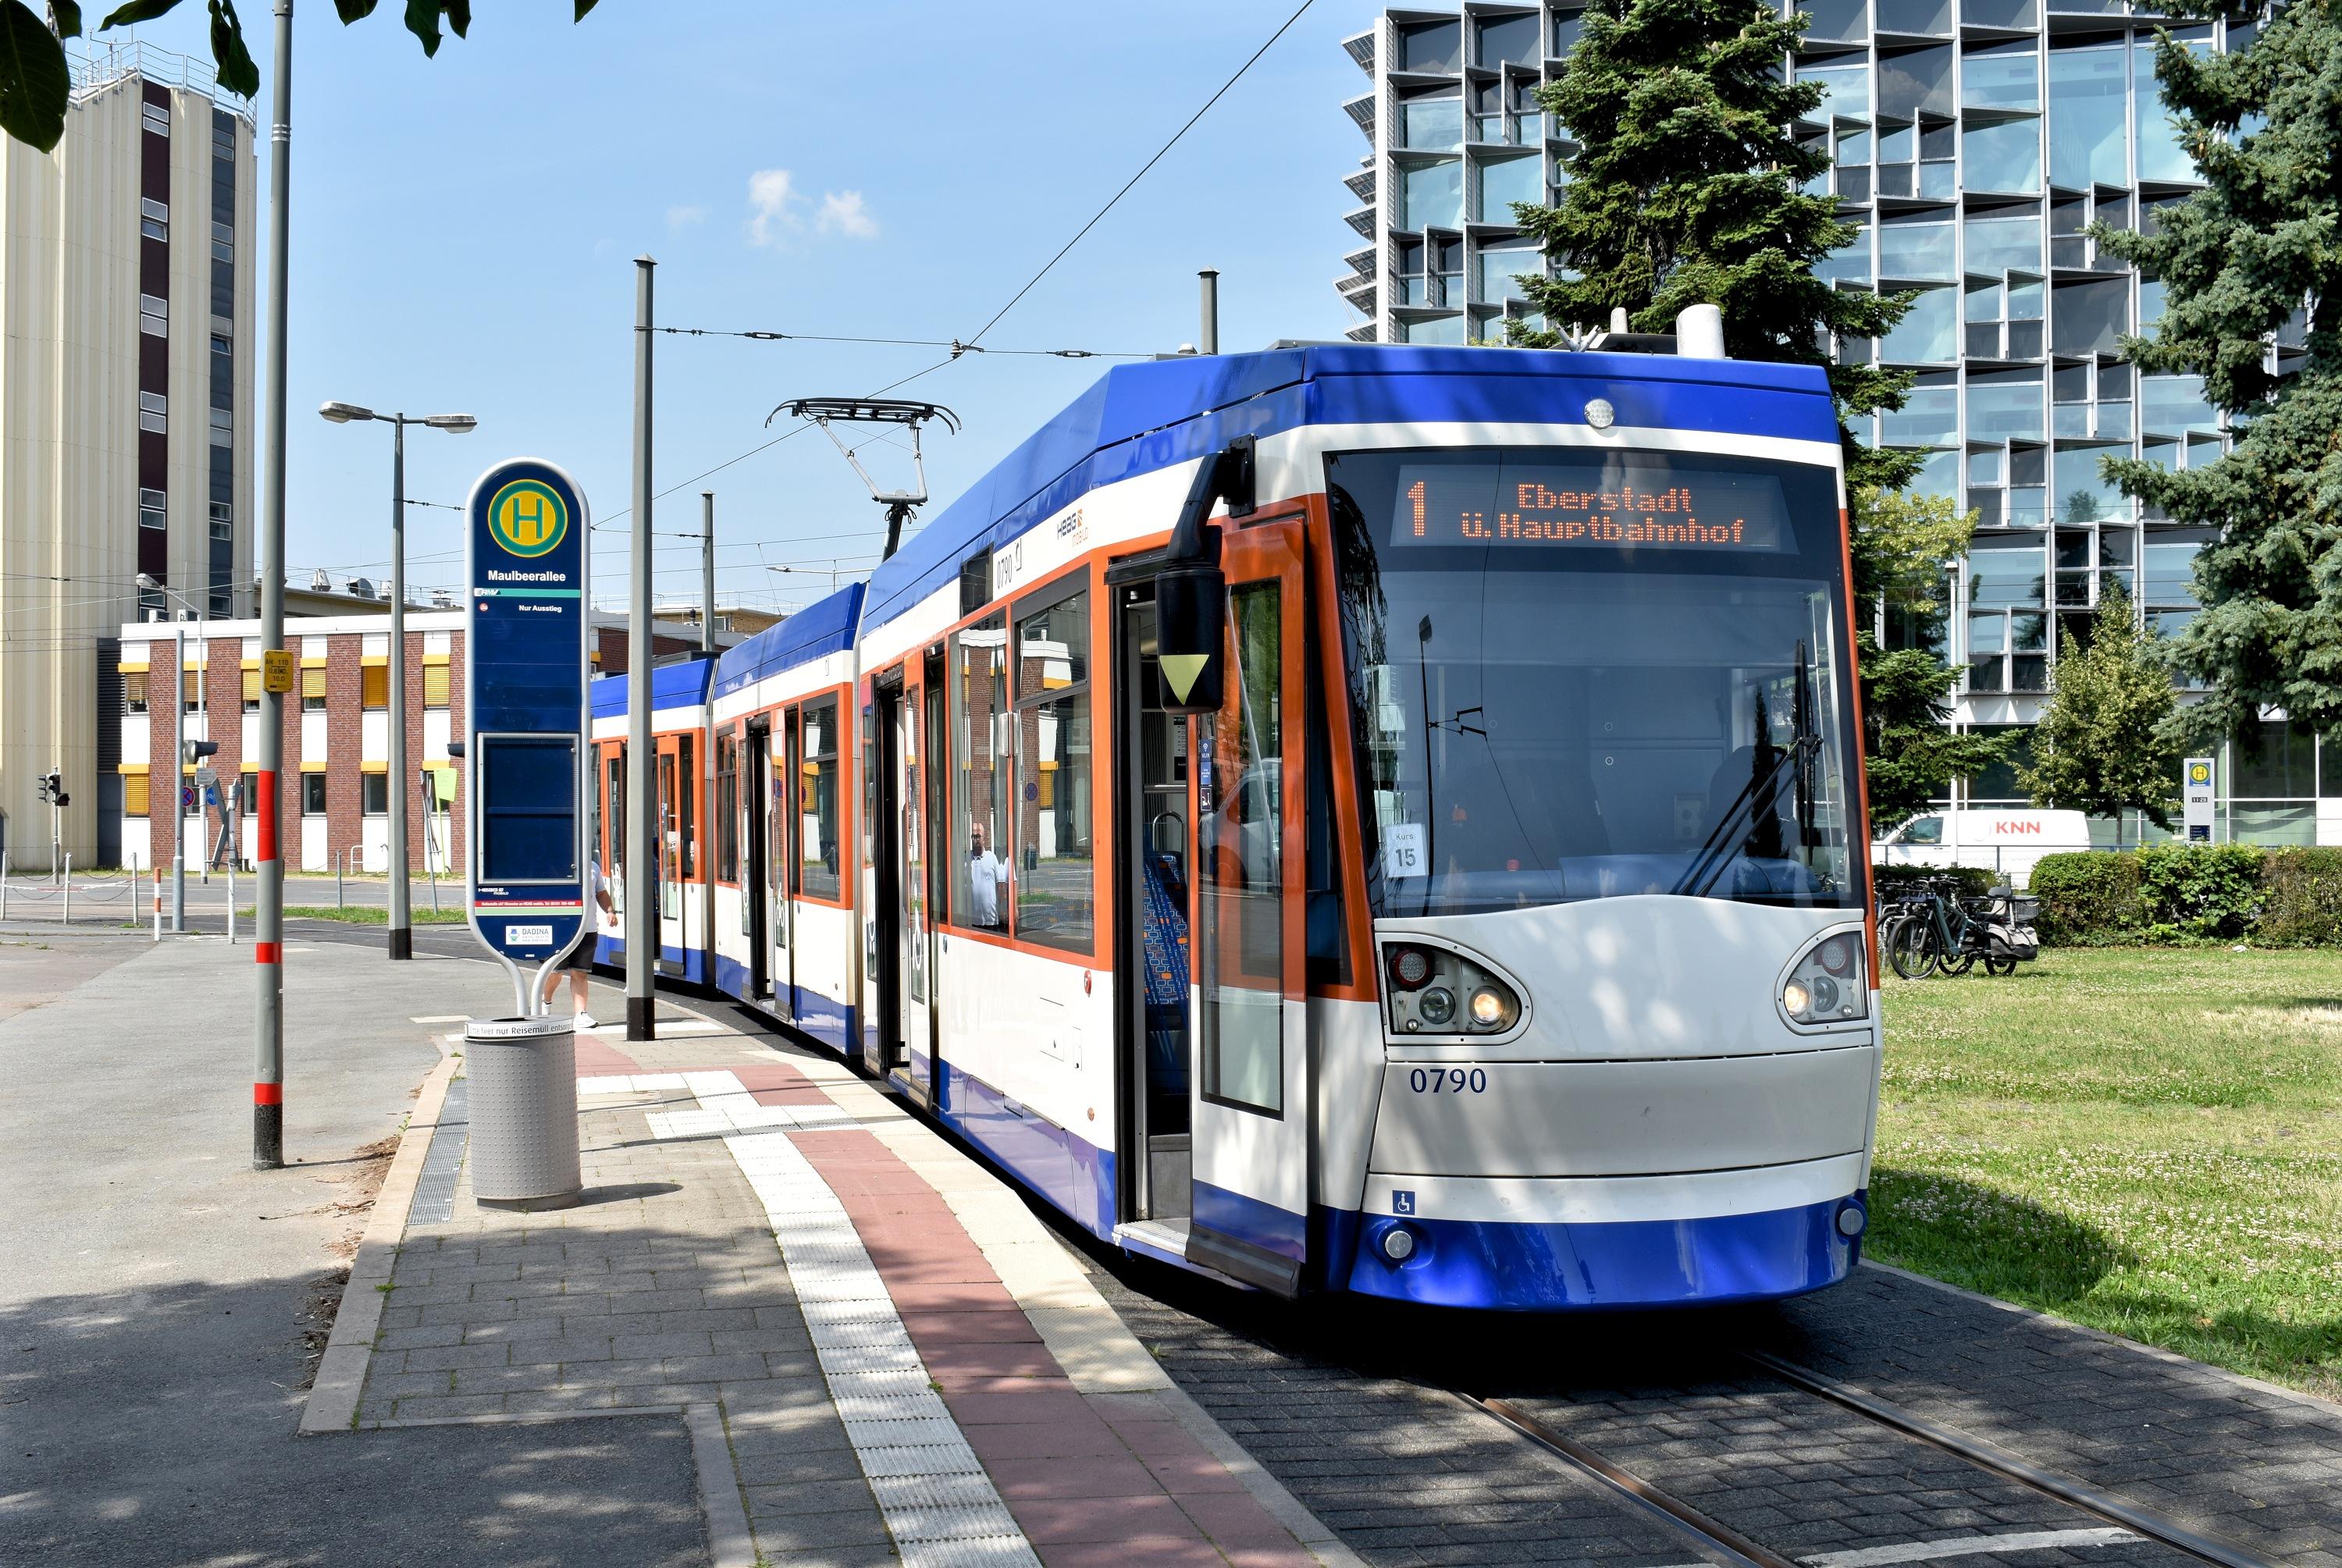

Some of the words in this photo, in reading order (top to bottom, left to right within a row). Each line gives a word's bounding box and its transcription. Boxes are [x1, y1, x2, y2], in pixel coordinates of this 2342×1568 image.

[1407, 481, 1425, 537] 1
[1517, 483, 1693, 513] Eberstadt
[513, 497, 543, 539] H
[488, 570, 567, 582] Maulbeerallee
[997, 554, 1013, 589] 0790
[532, 605, 562, 613] Ausstieg
[1995, 821, 2041, 834] KNN
[1395, 848, 1416, 867] 15
[481, 1026, 493, 1035] hier
[511, 1024, 549, 1034] Reisemüll
[1410, 1068, 1486, 1093] 0790
